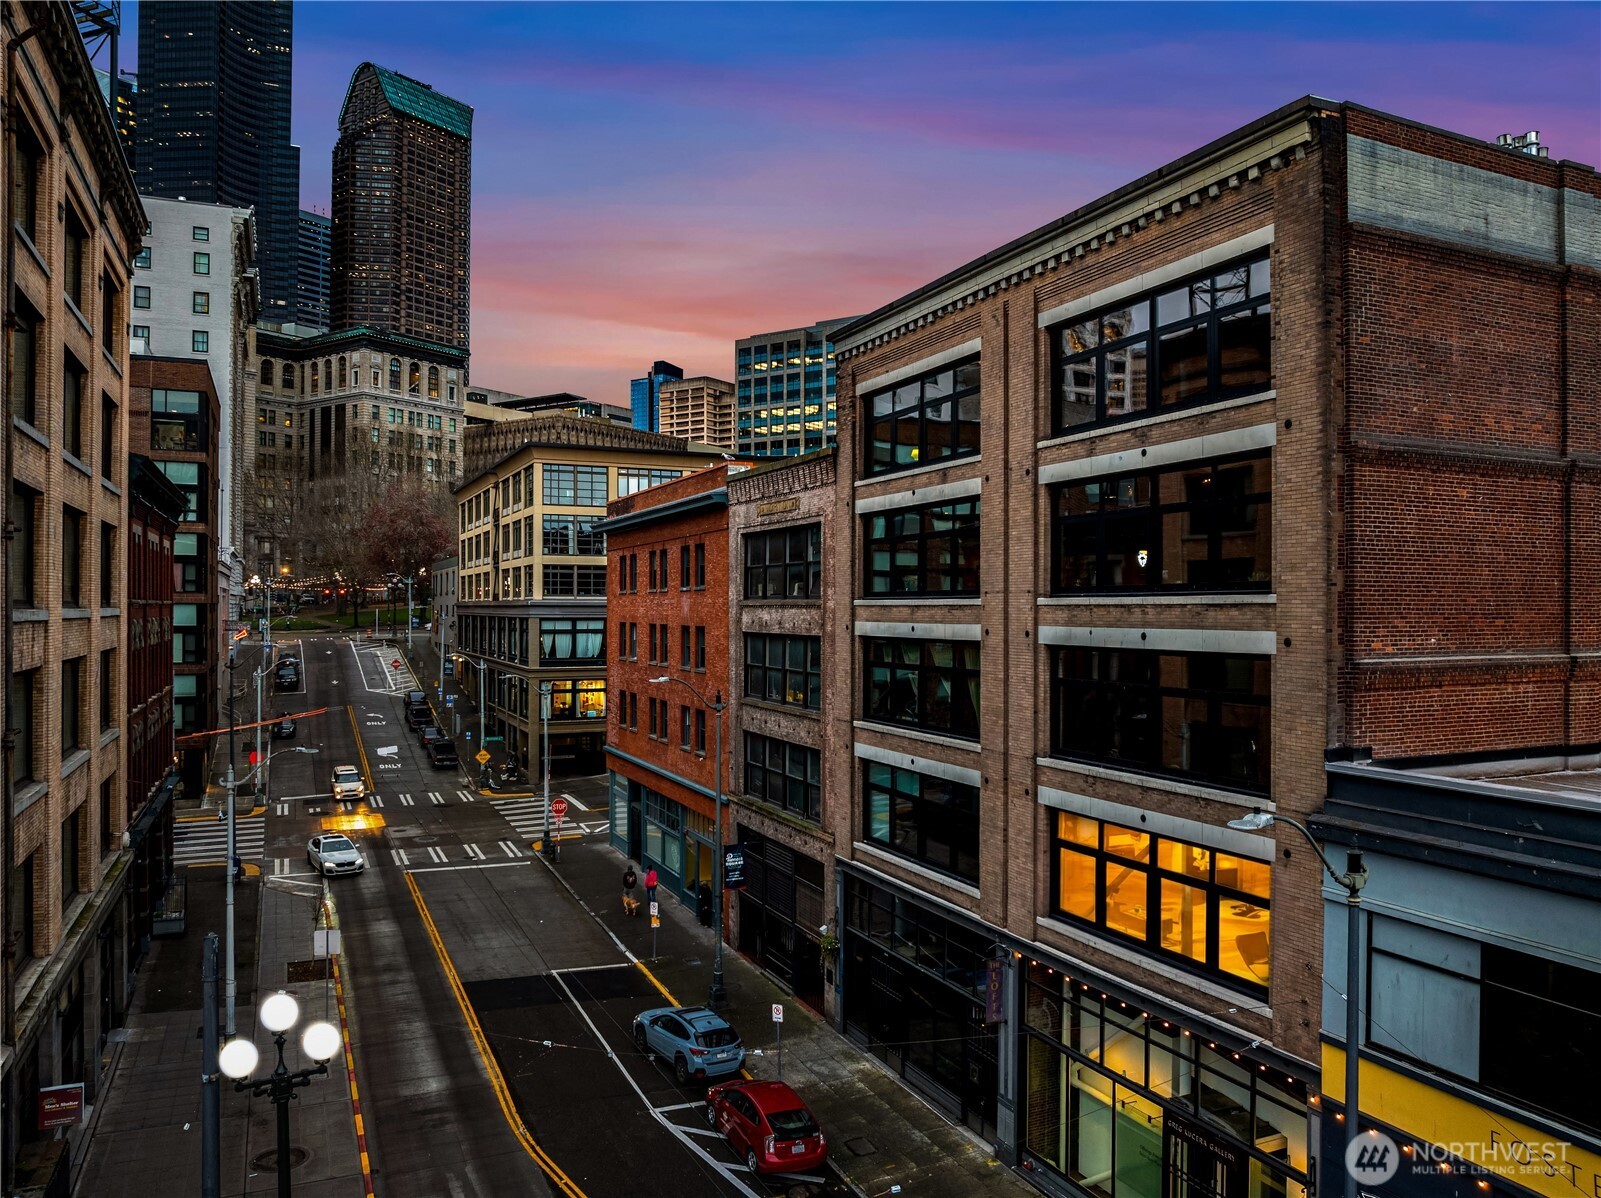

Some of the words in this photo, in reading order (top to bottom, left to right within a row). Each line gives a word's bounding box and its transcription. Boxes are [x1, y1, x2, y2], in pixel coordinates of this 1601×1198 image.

[552, 803, 567, 811] STOP
[990, 971, 999, 1021] LOFTS
[1167, 1119, 1183, 1133] GREG
[1209, 1143, 1235, 1162] GALLERY
